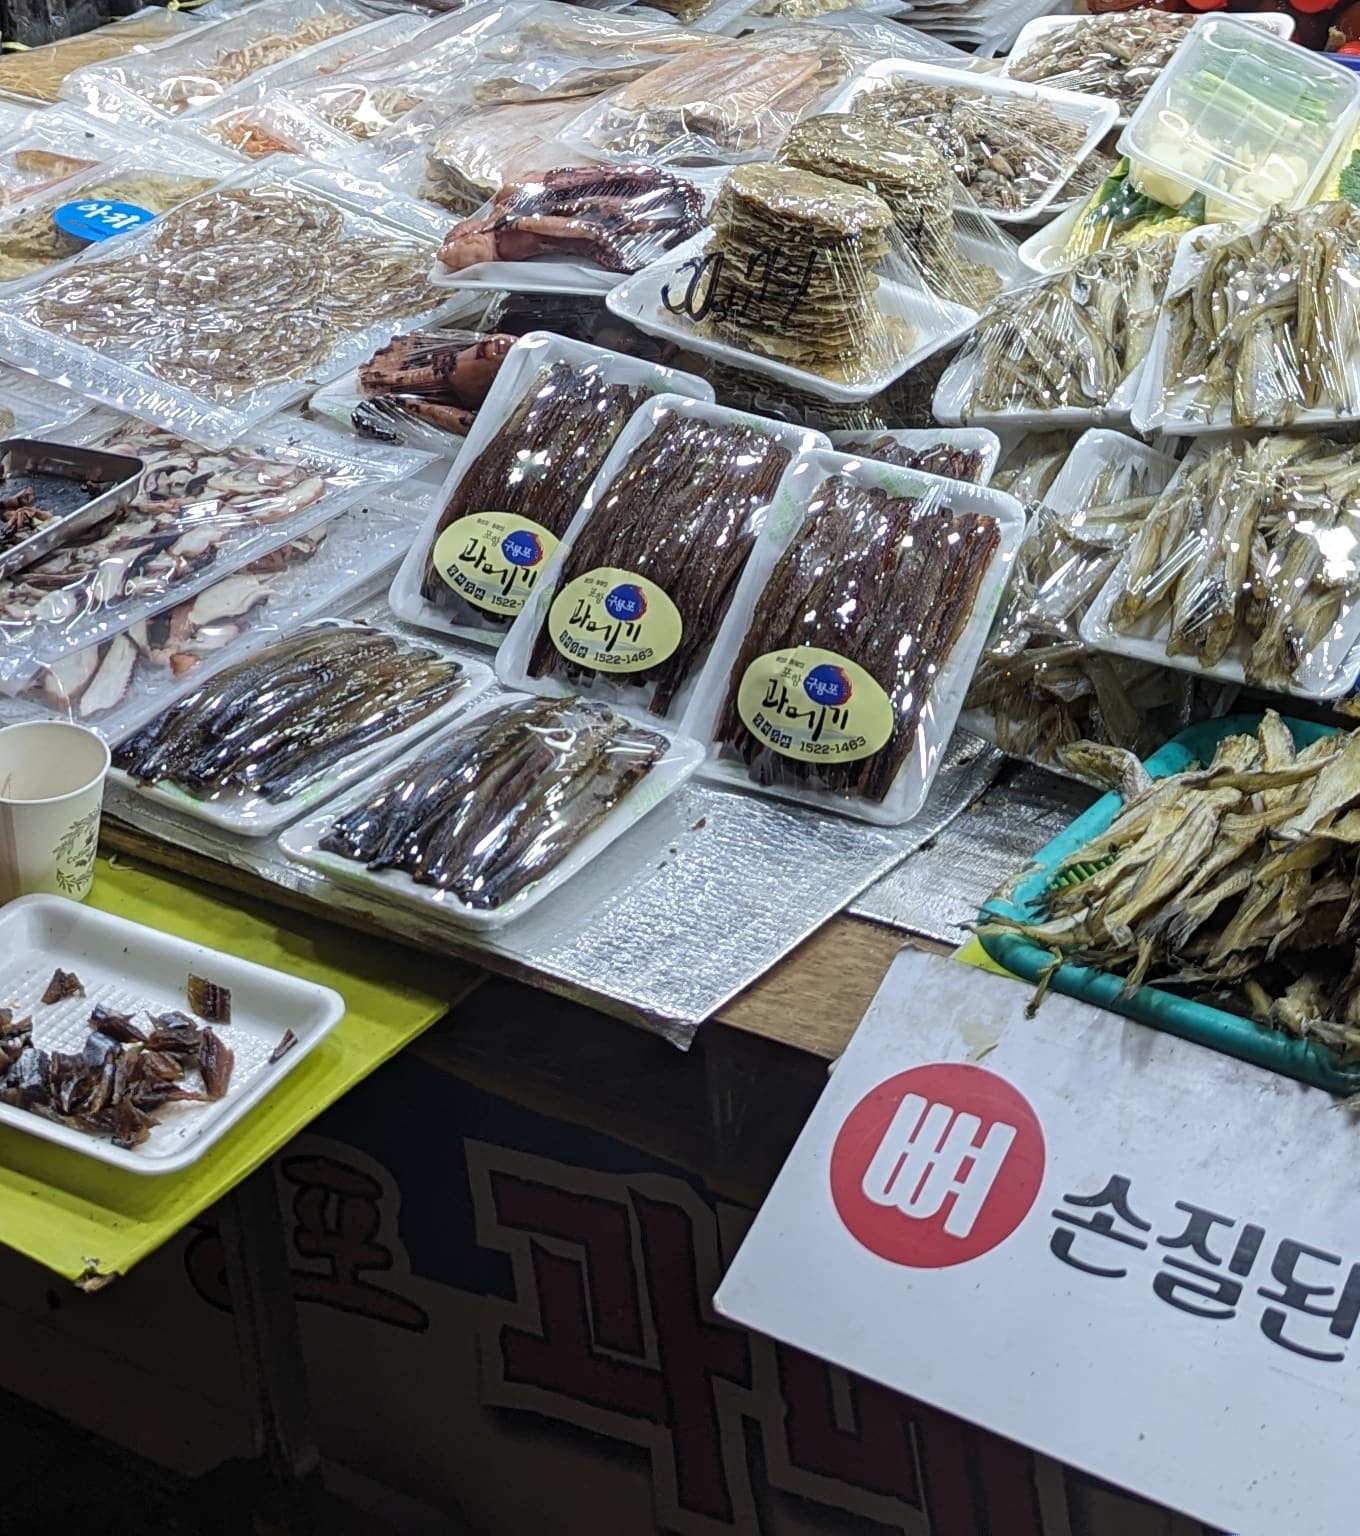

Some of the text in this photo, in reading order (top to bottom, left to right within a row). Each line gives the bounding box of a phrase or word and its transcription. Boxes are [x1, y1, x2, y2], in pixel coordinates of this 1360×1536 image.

[76, 203, 141, 230] 아귀
[504, 539, 533, 559] 구룡포
[458, 537, 538, 596] 과메기
[608, 593, 637, 613] 구룡포
[569, 599, 642, 652] 과메기
[806, 676, 839, 696] 구룡포
[762, 678, 848, 742] 과메기
